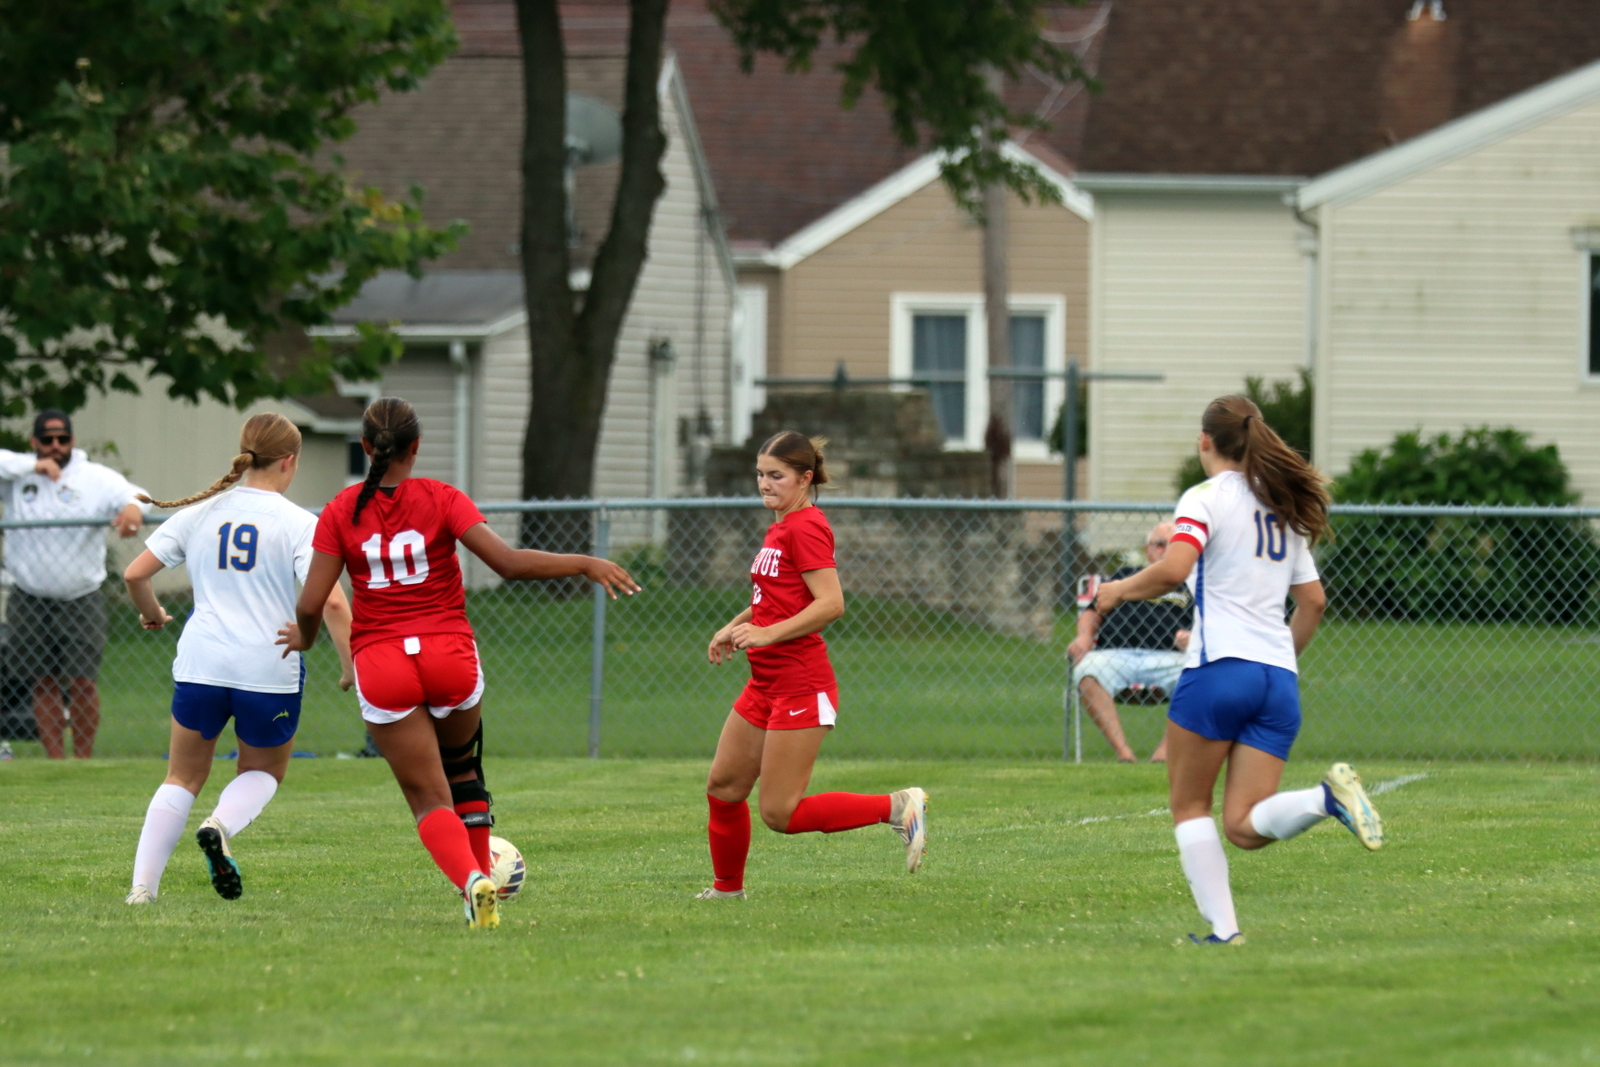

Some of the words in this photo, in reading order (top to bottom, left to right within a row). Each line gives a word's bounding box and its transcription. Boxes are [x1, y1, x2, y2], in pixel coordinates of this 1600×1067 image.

[217, 521, 259, 572] 19
[361, 529, 430, 589] 10
[1253, 509, 1288, 564] 10
